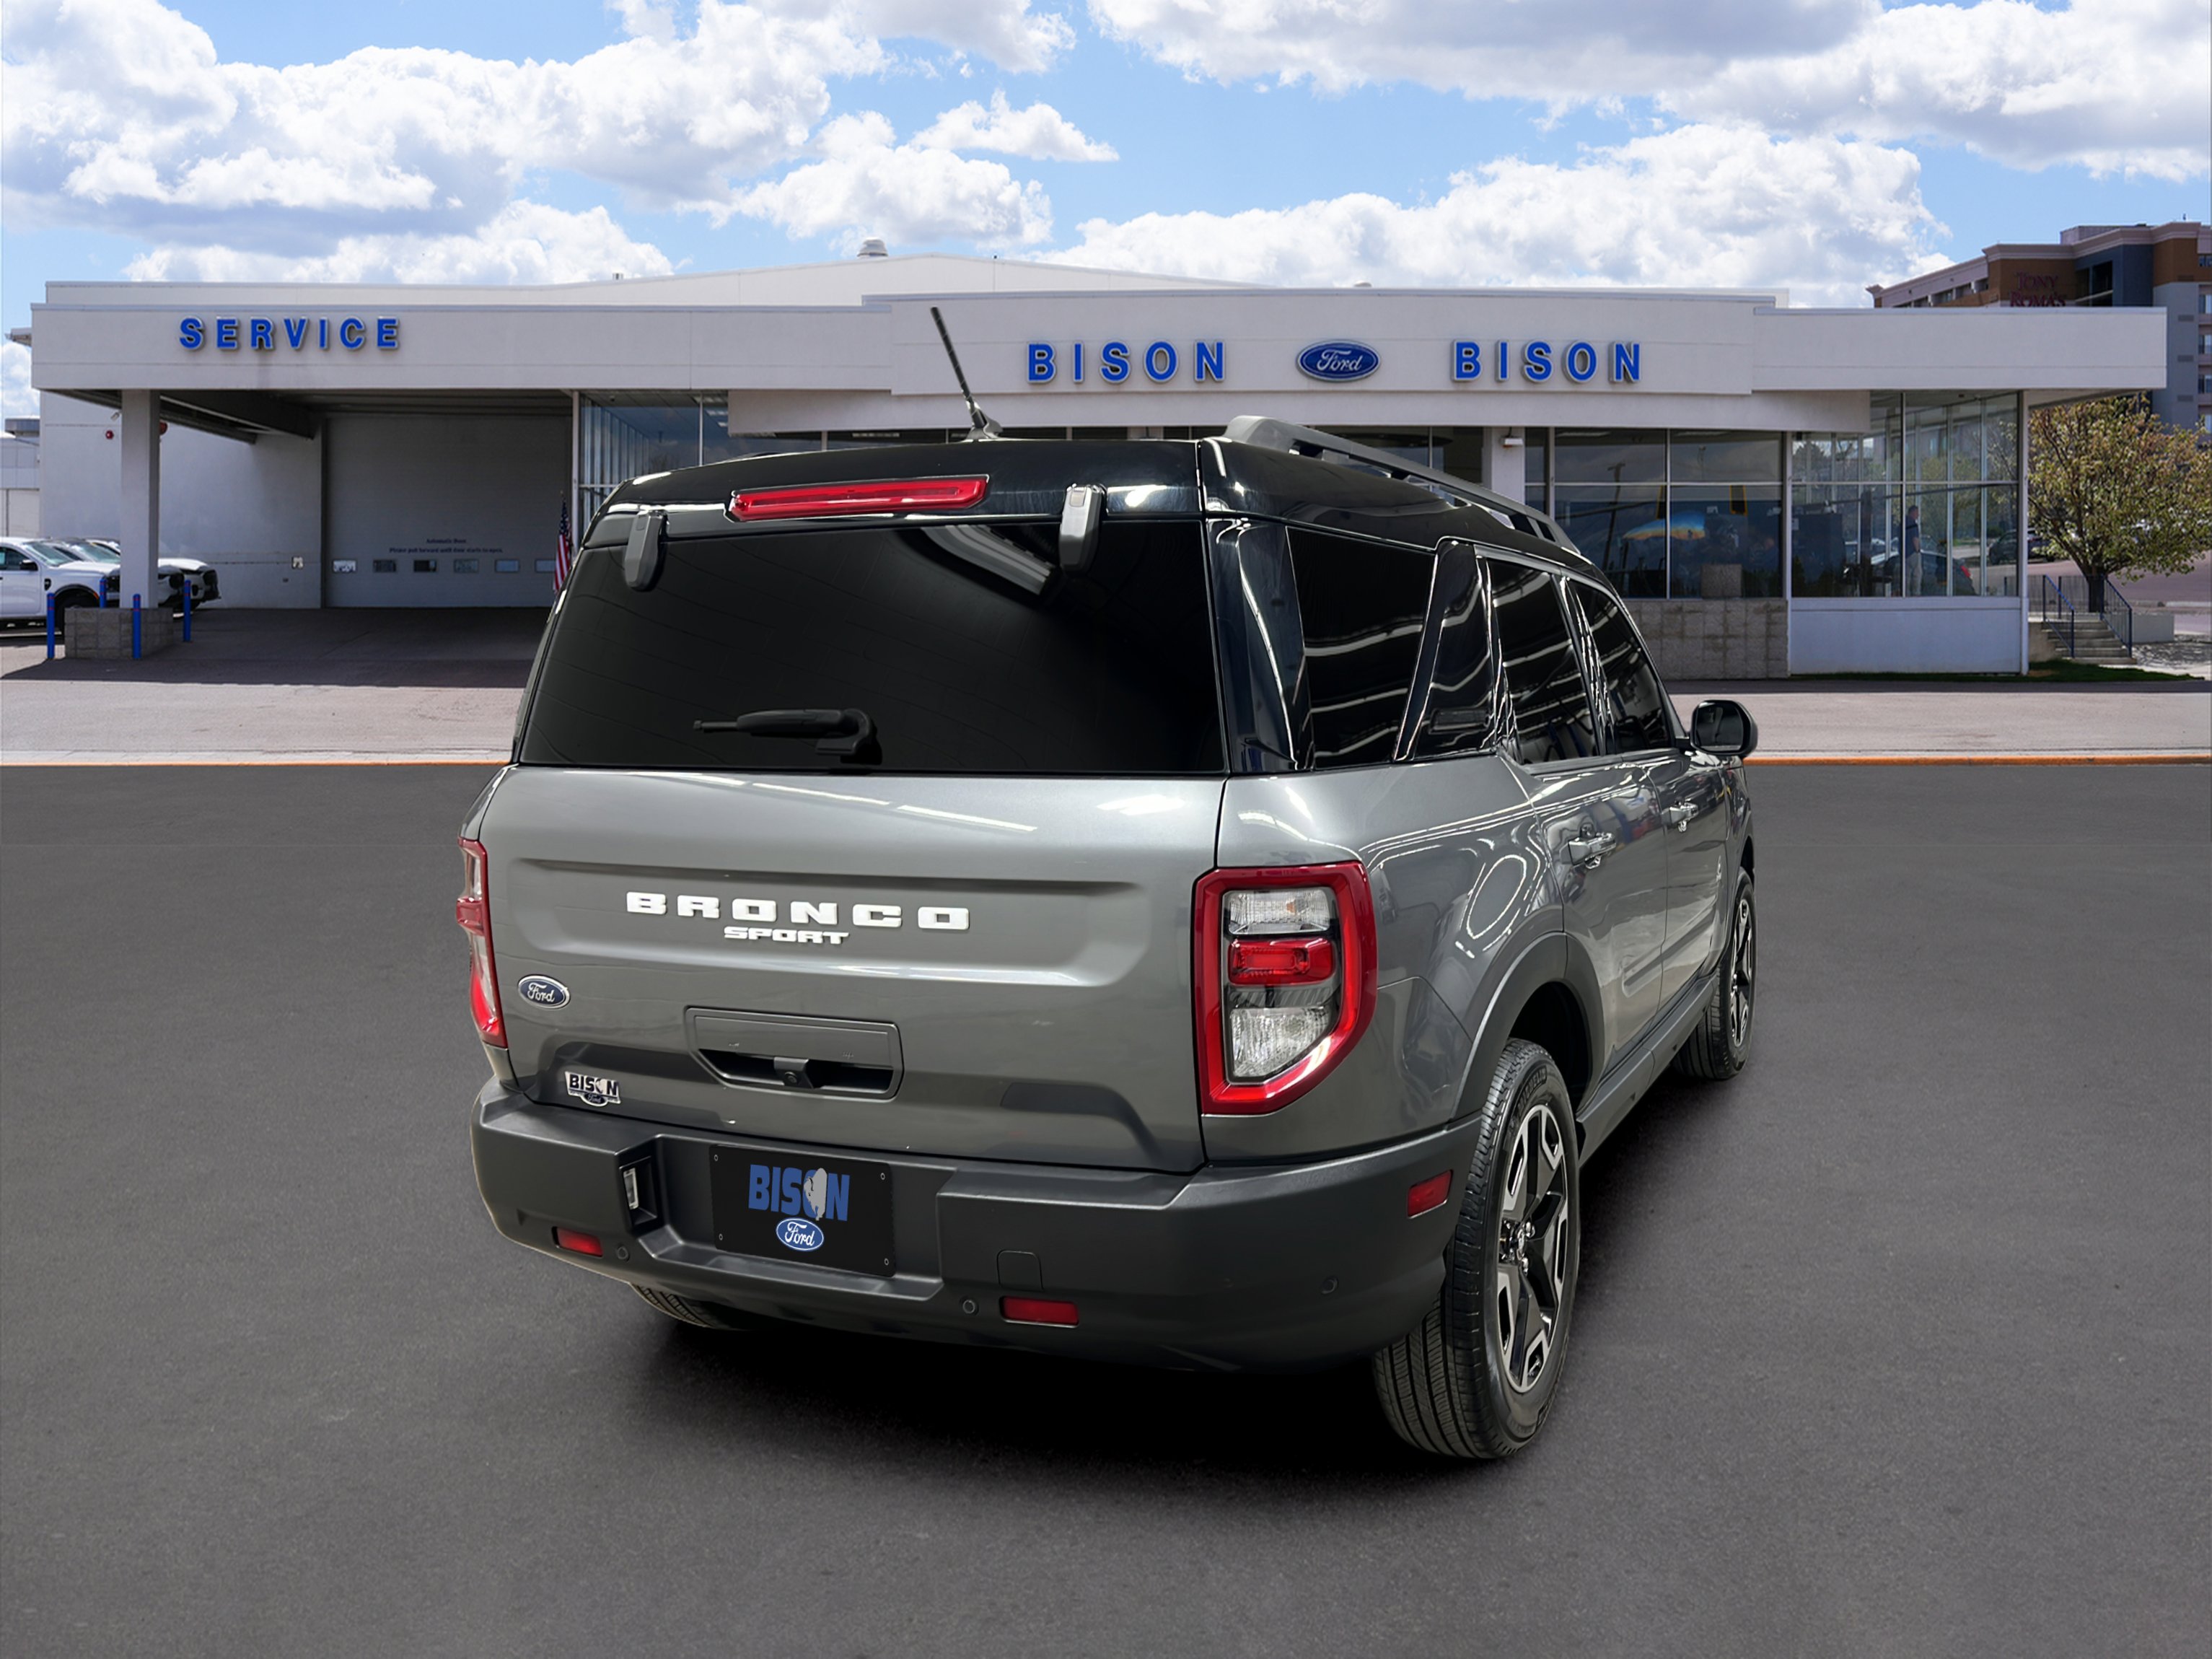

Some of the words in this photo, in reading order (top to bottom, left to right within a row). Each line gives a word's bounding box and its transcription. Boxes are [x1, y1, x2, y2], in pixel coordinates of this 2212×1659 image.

[2014, 272, 2058, 289] TONY
[179, 316, 400, 349] SERVICE
[1027, 341, 1225, 382] BISON
[1316, 348, 1363, 372] Ford
[1451, 339, 1642, 382] BISON
[626, 891, 970, 930] BRONCO
[724, 926, 850, 945] SPORT
[527, 982, 555, 1002] Ford
[784, 1222, 815, 1246] Ford
